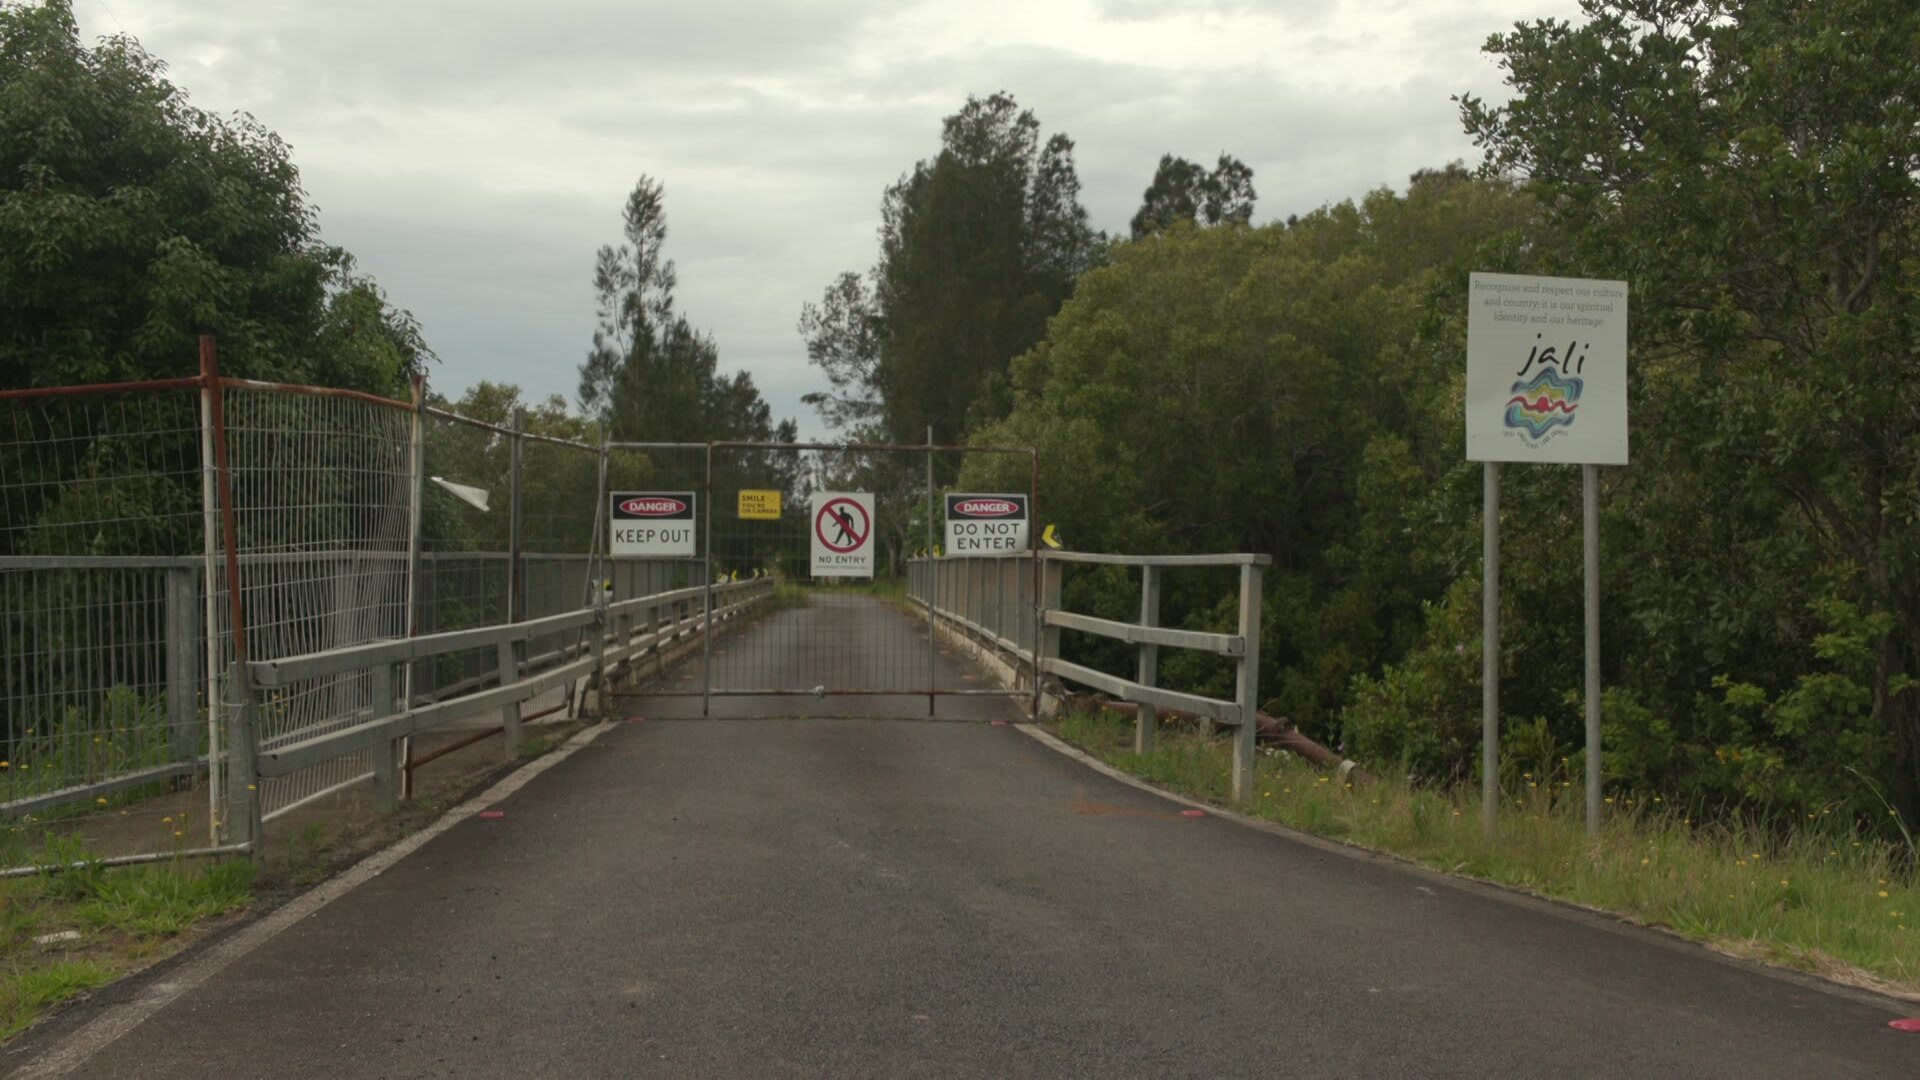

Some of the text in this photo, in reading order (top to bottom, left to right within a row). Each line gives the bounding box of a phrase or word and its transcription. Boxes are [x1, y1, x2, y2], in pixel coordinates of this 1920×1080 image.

[1523, 284, 1540, 294] and
[1542, 286, 1574, 297] respect
[1575, 289, 1591, 297] our
[1593, 287, 1624, 298] culture
[1484, 296, 1501, 306] and
[1560, 302, 1576, 311] our
[1577, 302, 1614, 313] spiritual
[1493, 311, 1529, 324] identity
[1530, 314, 1548, 324] and
[1549, 316, 1565, 325] our
[1517, 332, 1590, 376] jali
[629, 502, 677, 512] DANGER
[964, 503, 1010, 512] DANGER
[615, 529, 691, 543] KEEP OUT
[953, 522, 1020, 536] DO NOT
[957, 537, 1016, 550] ENTER
[818, 555, 866, 564] NO ENTRY
